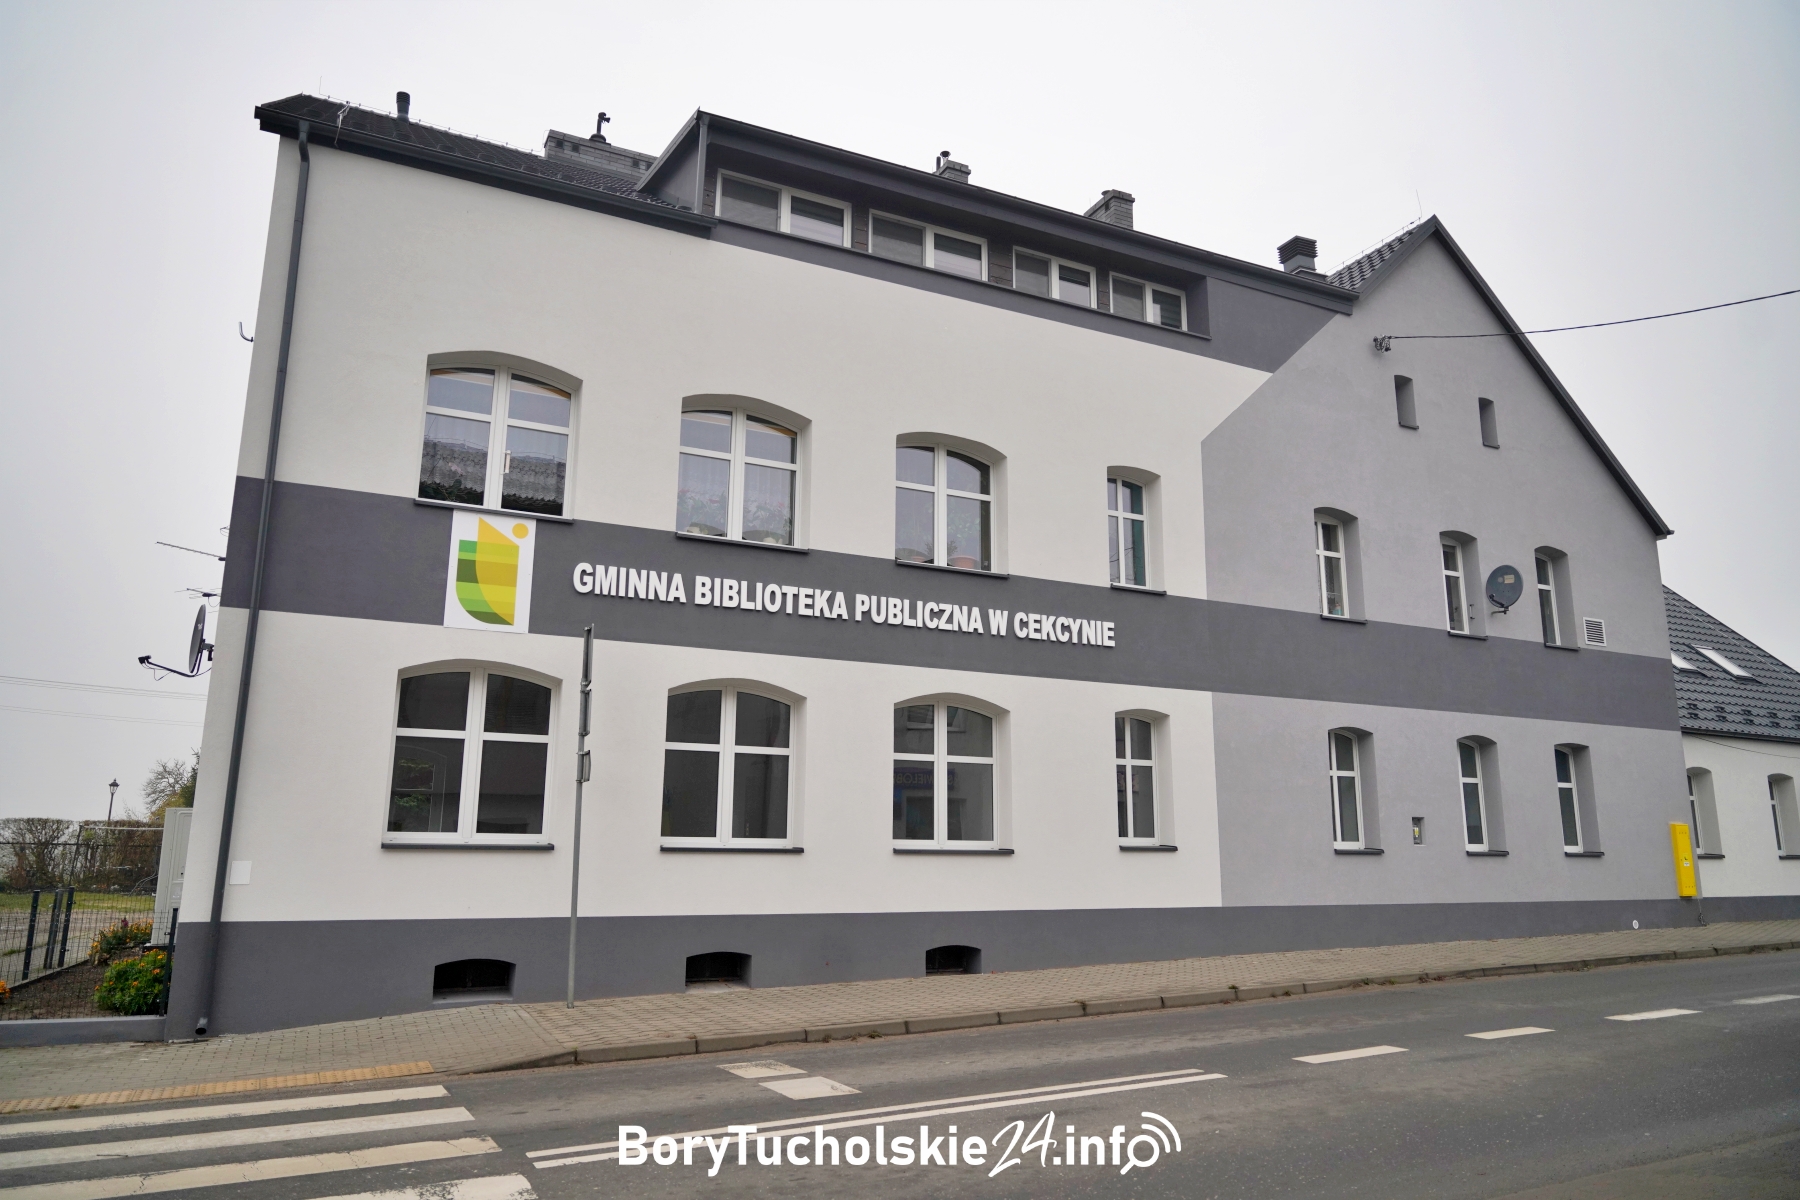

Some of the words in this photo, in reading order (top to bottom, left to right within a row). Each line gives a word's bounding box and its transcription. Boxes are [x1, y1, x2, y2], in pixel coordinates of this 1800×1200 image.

[573, 562, 687, 603] GMINNA
[694, 575, 849, 620] BIBLIOTEKA
[855, 593, 984, 635] PUBLICZNA
[987, 609, 1009, 636] W
[1013, 611, 1116, 648] CEKCYNIE
